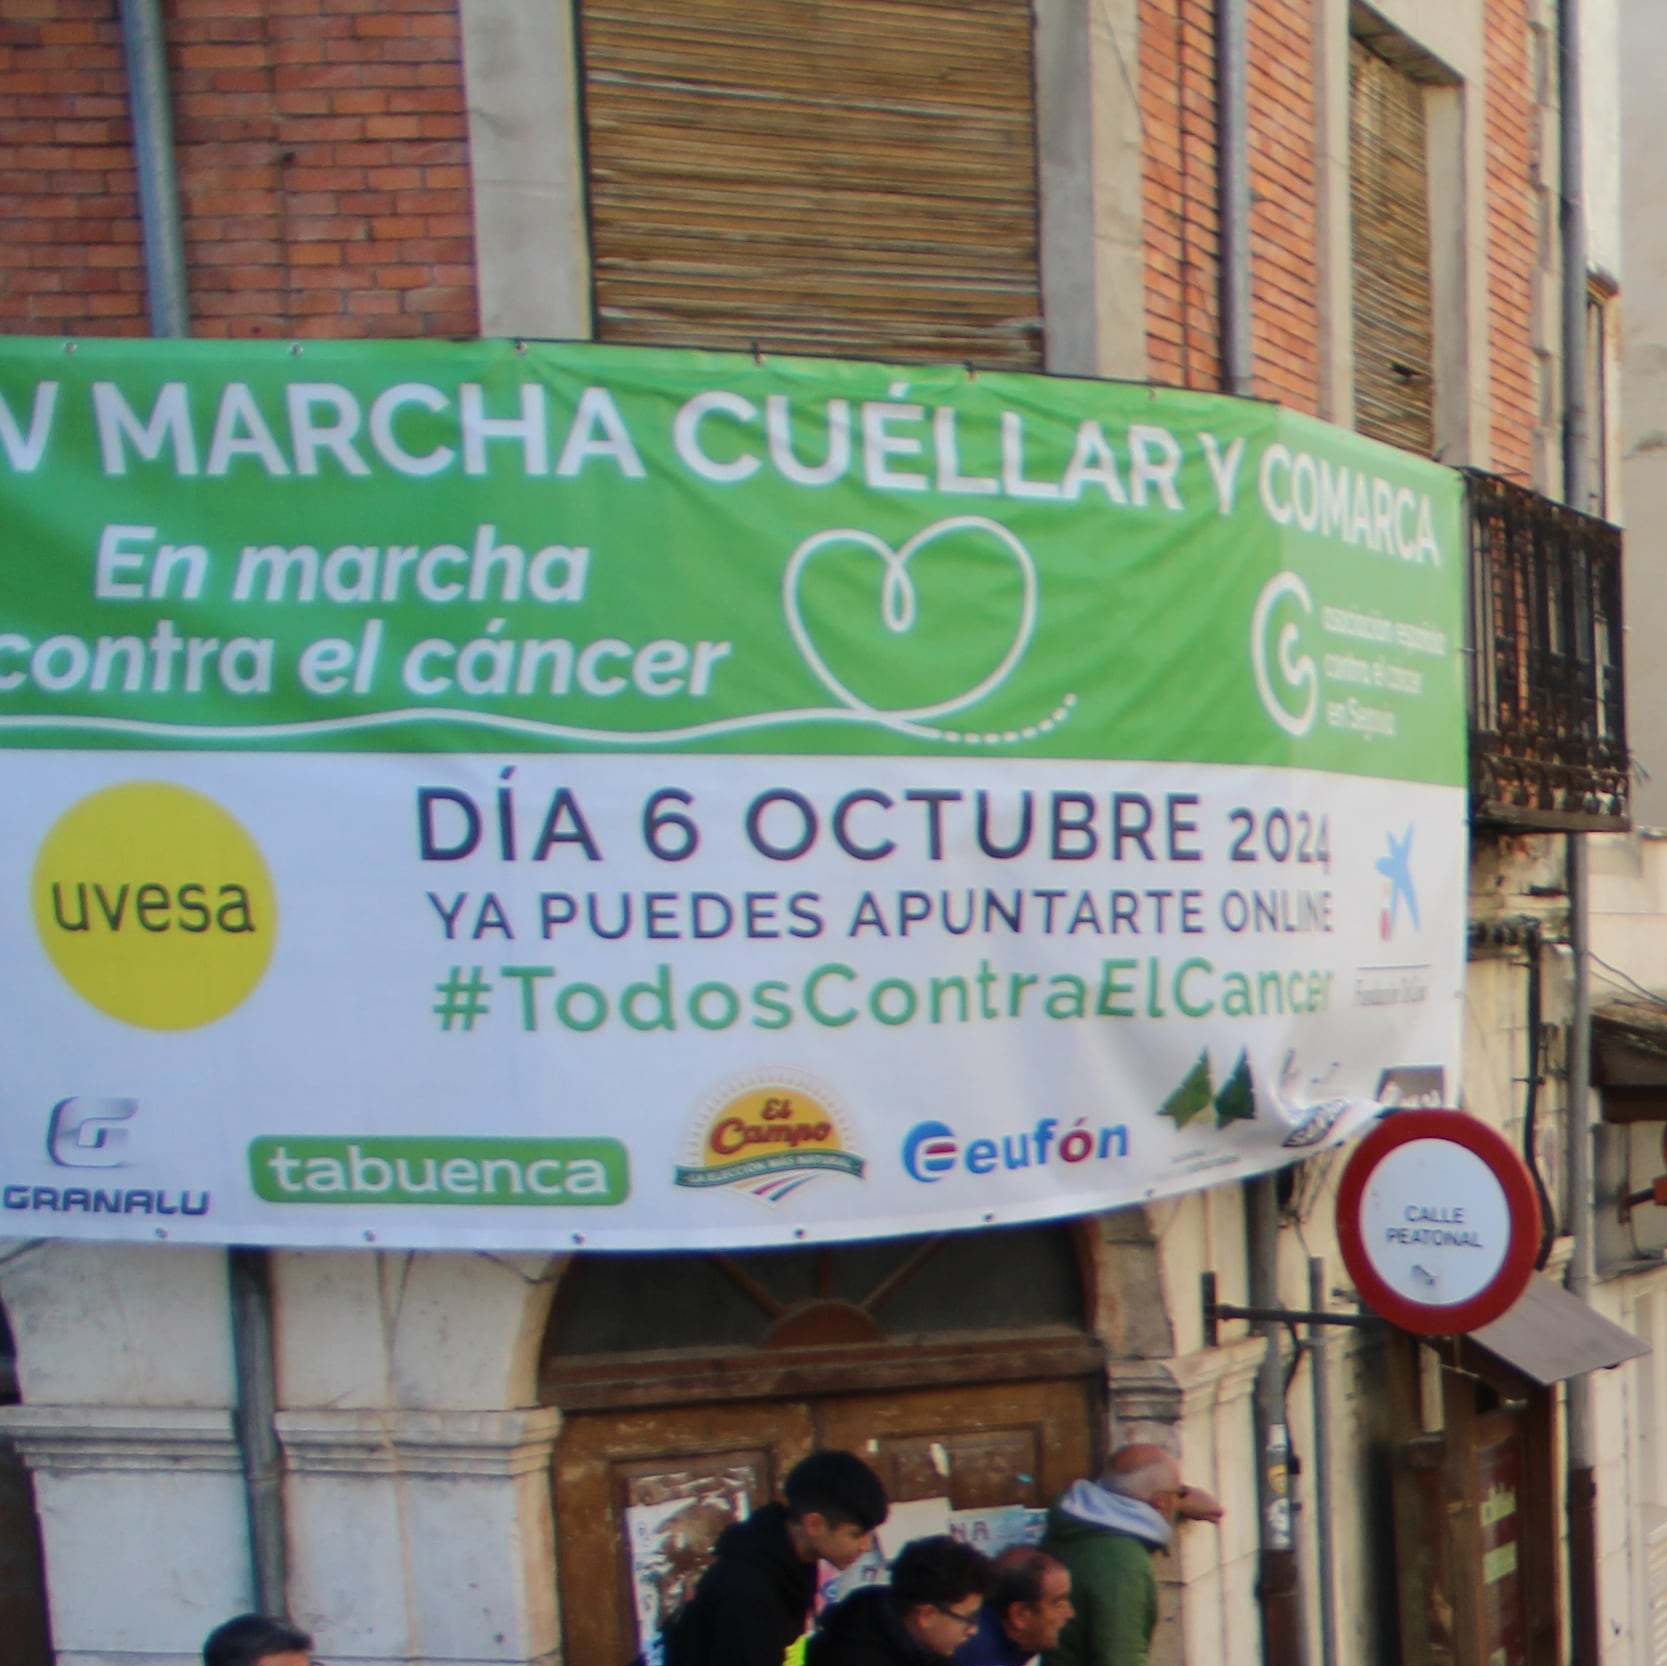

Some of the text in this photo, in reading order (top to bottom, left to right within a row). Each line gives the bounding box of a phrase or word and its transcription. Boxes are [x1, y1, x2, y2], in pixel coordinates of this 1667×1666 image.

[92, 380, 647, 478] MARCHA
[673, 382, 1184, 511] CUÉLLAR
[1200, 430, 1246, 516] Y
[1258, 442, 1443, 568] COMARCA
[94, 523, 591, 603] En marcha
[0, 617, 732, 697] contra el cáncer
[415, 765, 1333, 875] DÍA 6 OCTUBRE 2024
[51, 880, 257, 934] uvesa
[426, 888, 1334, 941] YA PUEDES APUNTARTE ONLINE
[432, 956, 1334, 1034] #TodosContraElCancer
[709, 1117, 832, 1156] Campo
[268, 1145, 609, 1196] tabuenca
[3, 1184, 211, 1216] GRANALU
[1404, 1205, 1465, 1224] CALLE
[1385, 1227, 1484, 1248] PEATONAL
